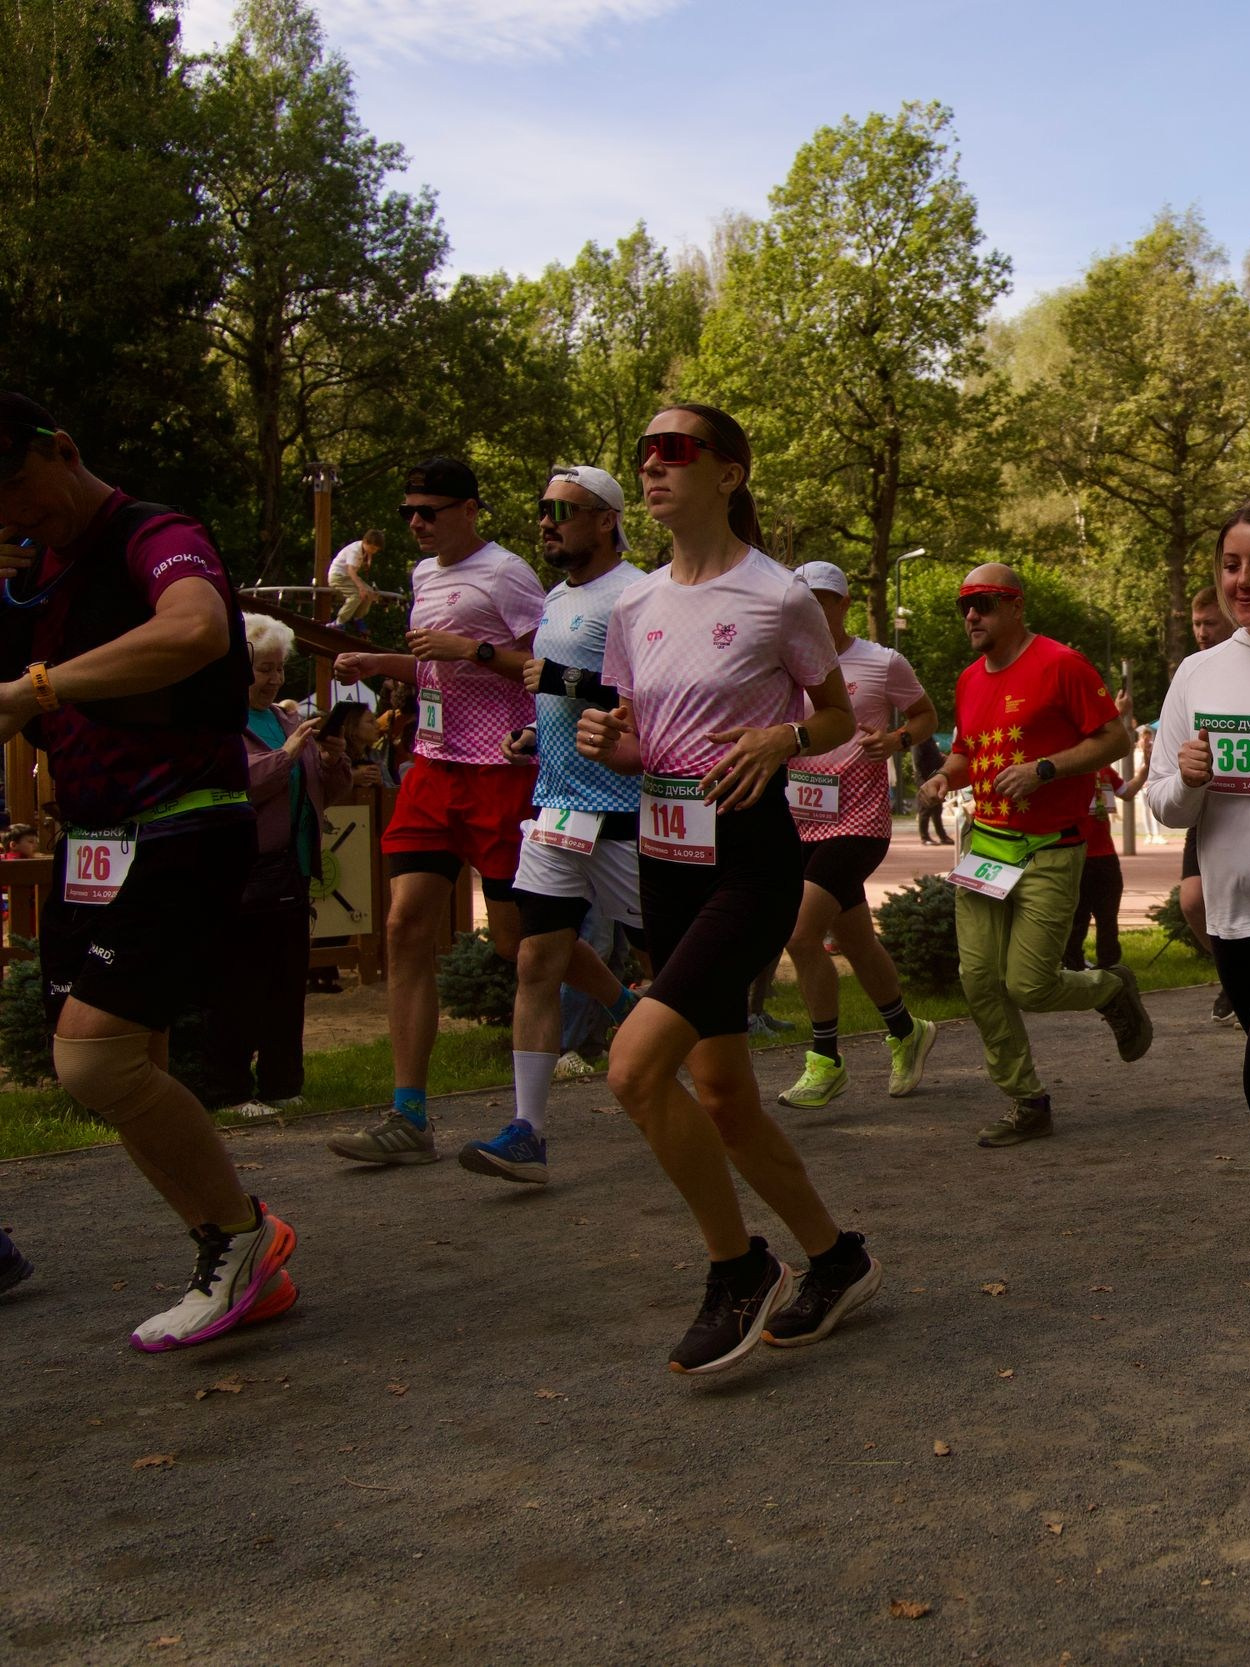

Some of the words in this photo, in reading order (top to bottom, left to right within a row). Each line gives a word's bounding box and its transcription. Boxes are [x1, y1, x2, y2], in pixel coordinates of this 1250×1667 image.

[1200, 718, 1236, 729] КРОСС
[665, 785, 705, 797] ДУБКИ
[796, 786, 823, 808] 122
[555, 809, 571, 831] 2
[650, 803, 687, 840] 114
[77, 845, 111, 881] 126
[672, 849, 706, 860] 14.09.25
[974, 863, 1004, 882] 63
